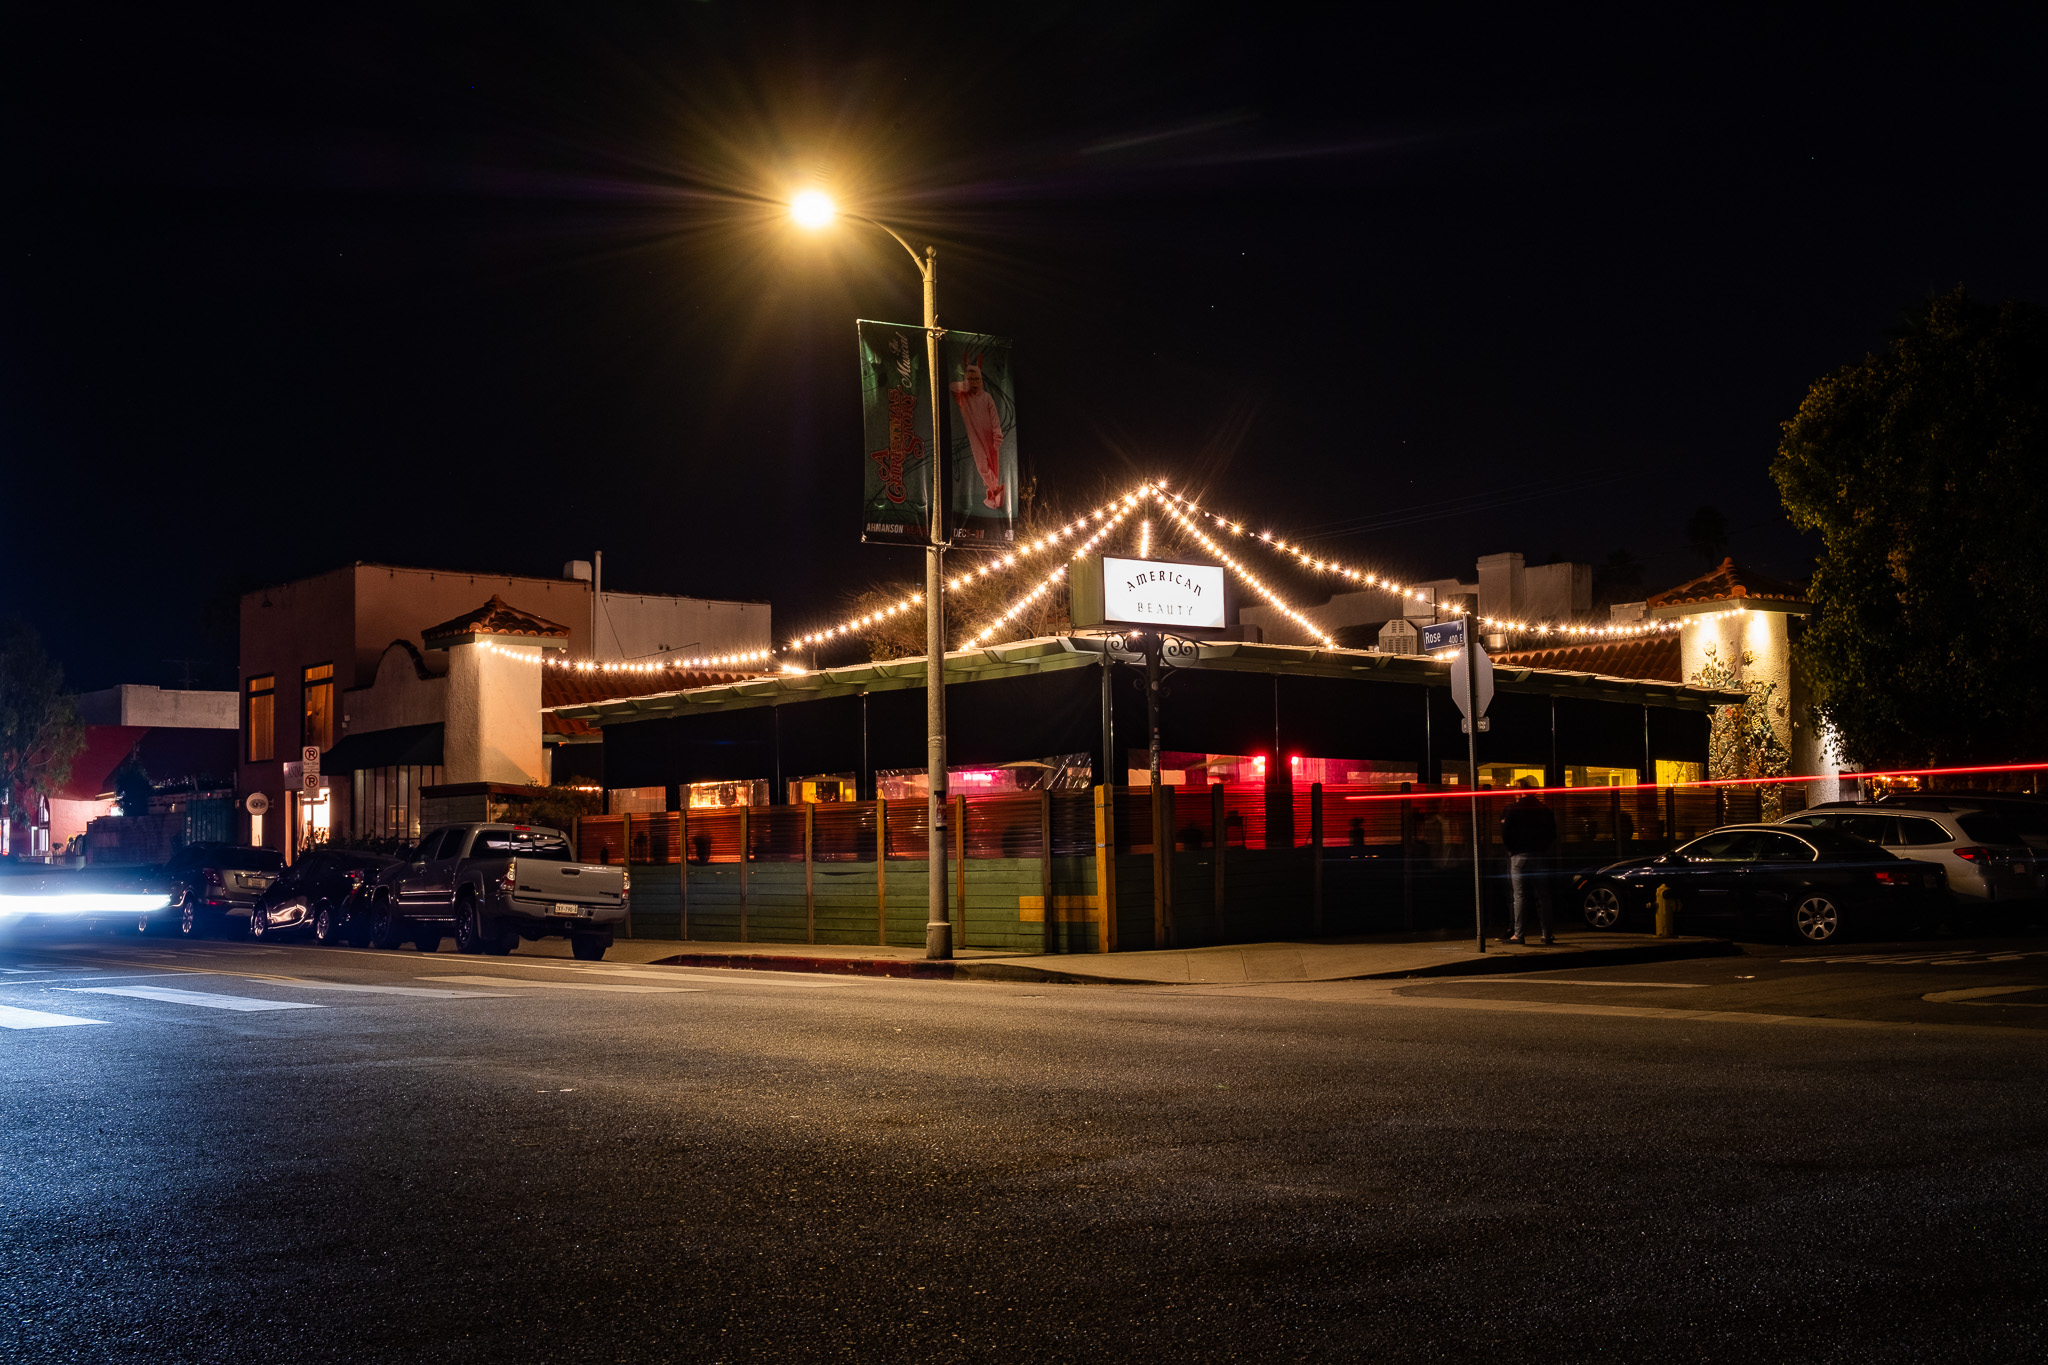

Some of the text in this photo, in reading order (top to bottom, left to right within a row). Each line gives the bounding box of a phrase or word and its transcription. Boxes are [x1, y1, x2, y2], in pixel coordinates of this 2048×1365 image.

[895, 331, 913, 389] Musical
[897, 384, 925, 459] STORY
[885, 388, 907, 504] CHRISTMAS
[871, 447, 890, 481] A
[866, 522, 904, 534] AHMANSON
[953, 527, 966, 538] DEC
[1126, 570, 1202, 597] AMERICAN
[1137, 602, 1193, 616] BEAUTY
[1425, 632, 1441, 645] Rose
[1448, 634, 1459, 644] 400
